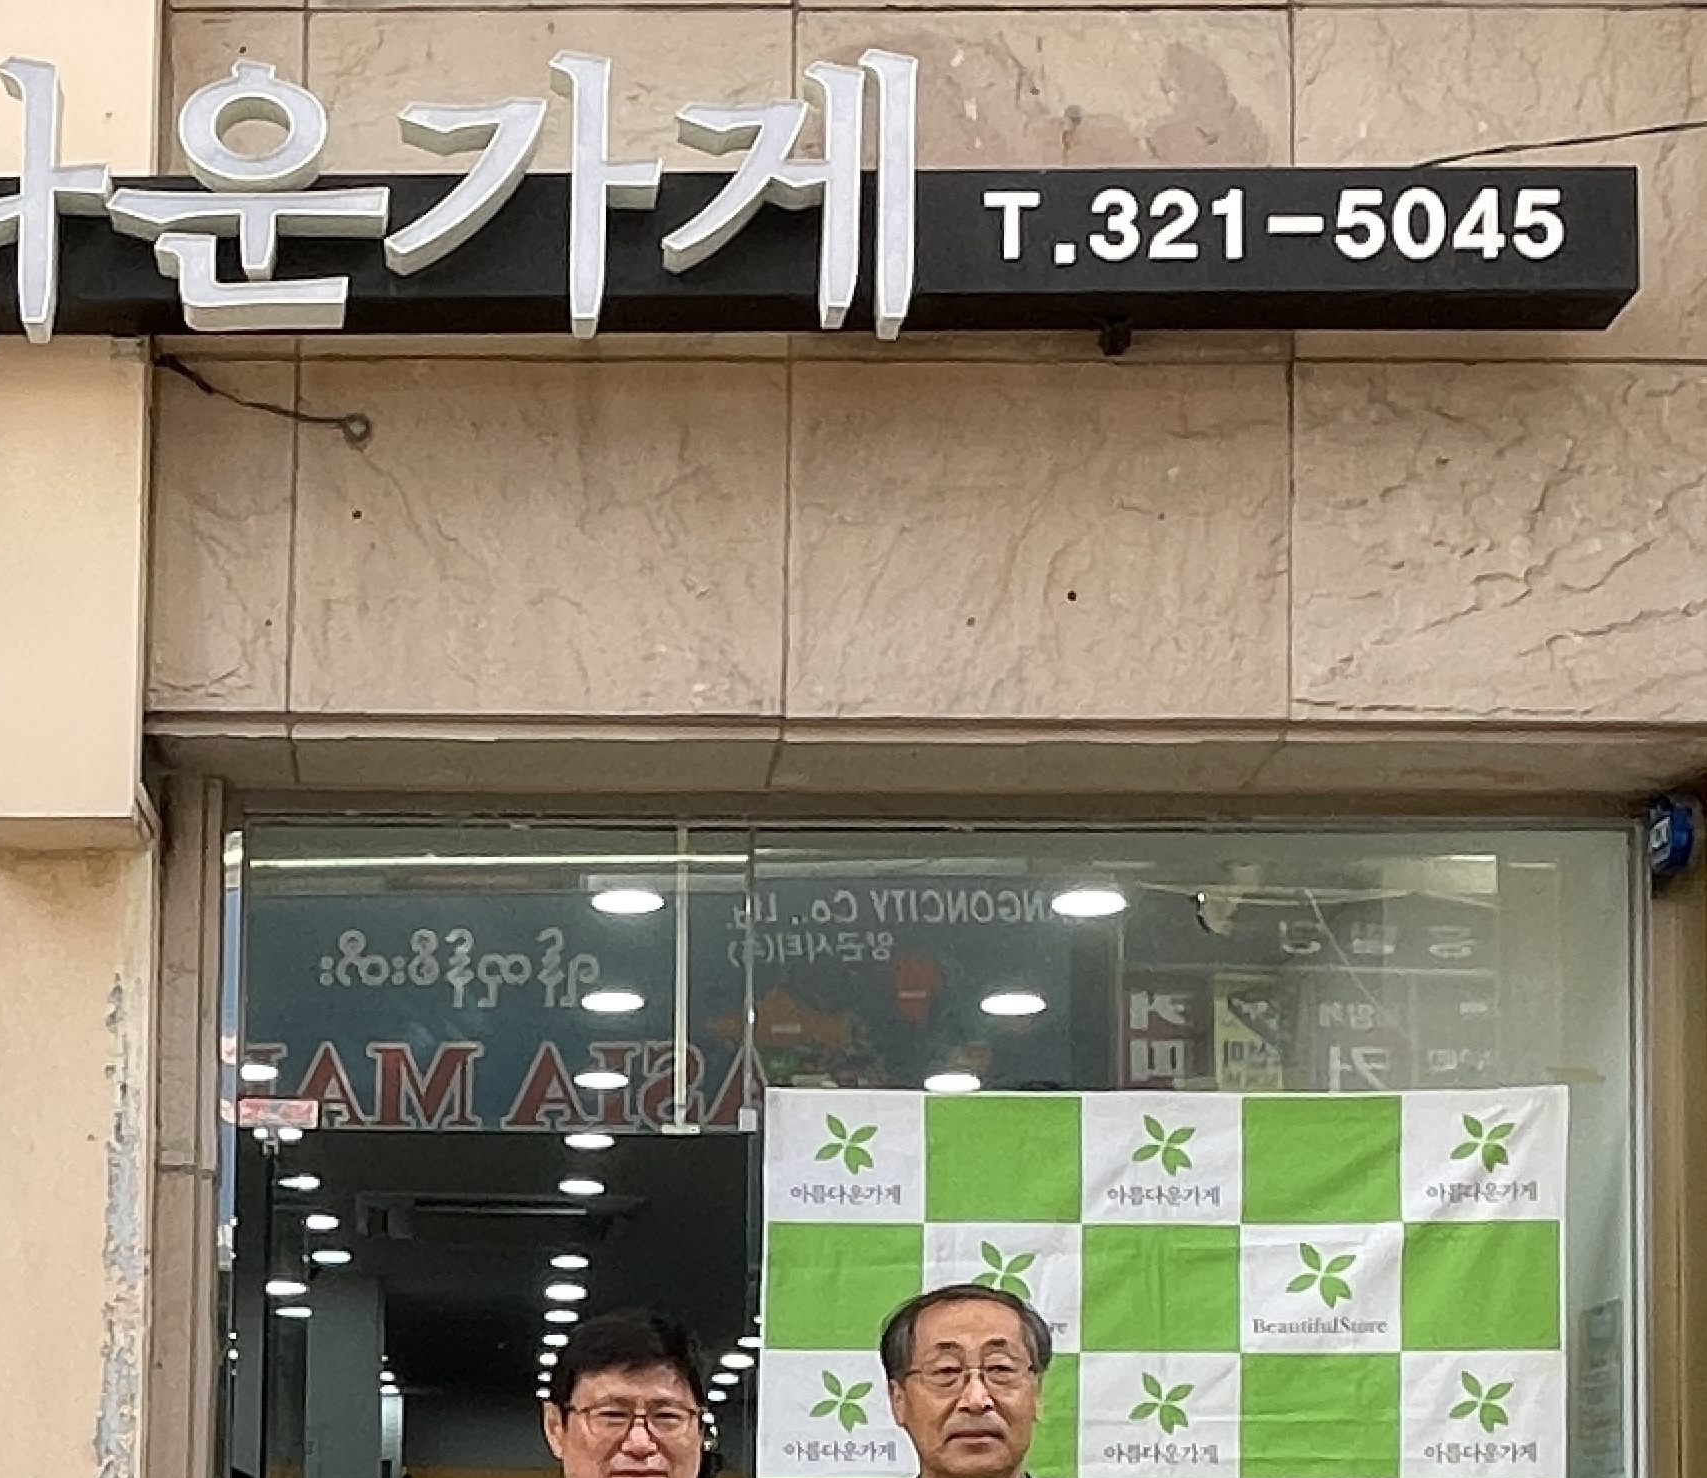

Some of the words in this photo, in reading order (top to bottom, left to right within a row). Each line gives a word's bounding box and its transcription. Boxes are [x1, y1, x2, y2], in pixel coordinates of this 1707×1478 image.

[789, 1184, 902, 1208] 아름다운가게
[1106, 1185, 1222, 1208] 아름다운가게
[1425, 1180, 1539, 1204] 아름다운가게
[1252, 1317, 1388, 1334] BeautifulStore
[783, 1440, 897, 1462] 아름다운가게
[1103, 1442, 1219, 1465] 아름다운가게
[1423, 1441, 1539, 1464] 아름다운가게
